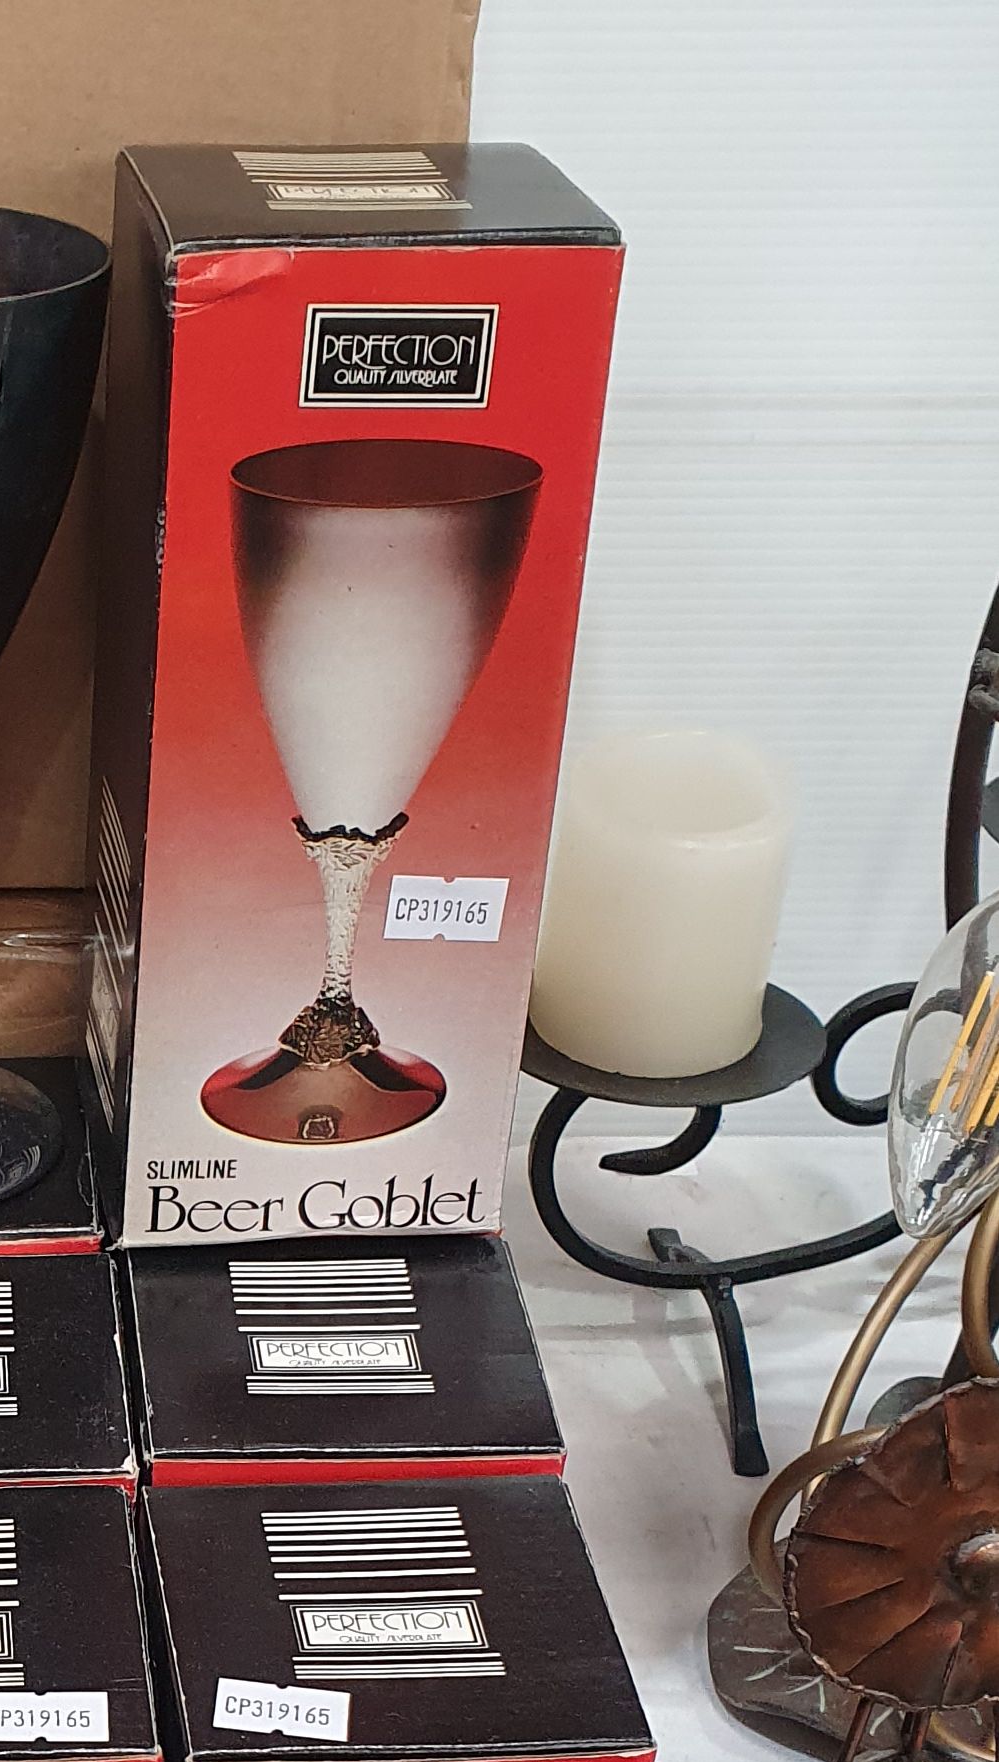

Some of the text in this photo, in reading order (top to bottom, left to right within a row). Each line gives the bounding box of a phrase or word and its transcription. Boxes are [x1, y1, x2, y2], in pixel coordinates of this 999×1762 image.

[323, 334, 475, 369] PERFECTION
[334, 368, 458, 387] QUALITY SILVERPLATE
[395, 897, 488, 925] CP319165
[146, 1159, 238, 1181] SLIMLINE
[145, 1174, 486, 1234] Beer Goblet
[267, 1342, 400, 1360] PERFECTION
[312, 1611, 462, 1635] PERFECTION
[225, 1695, 330, 1726] CP319165
